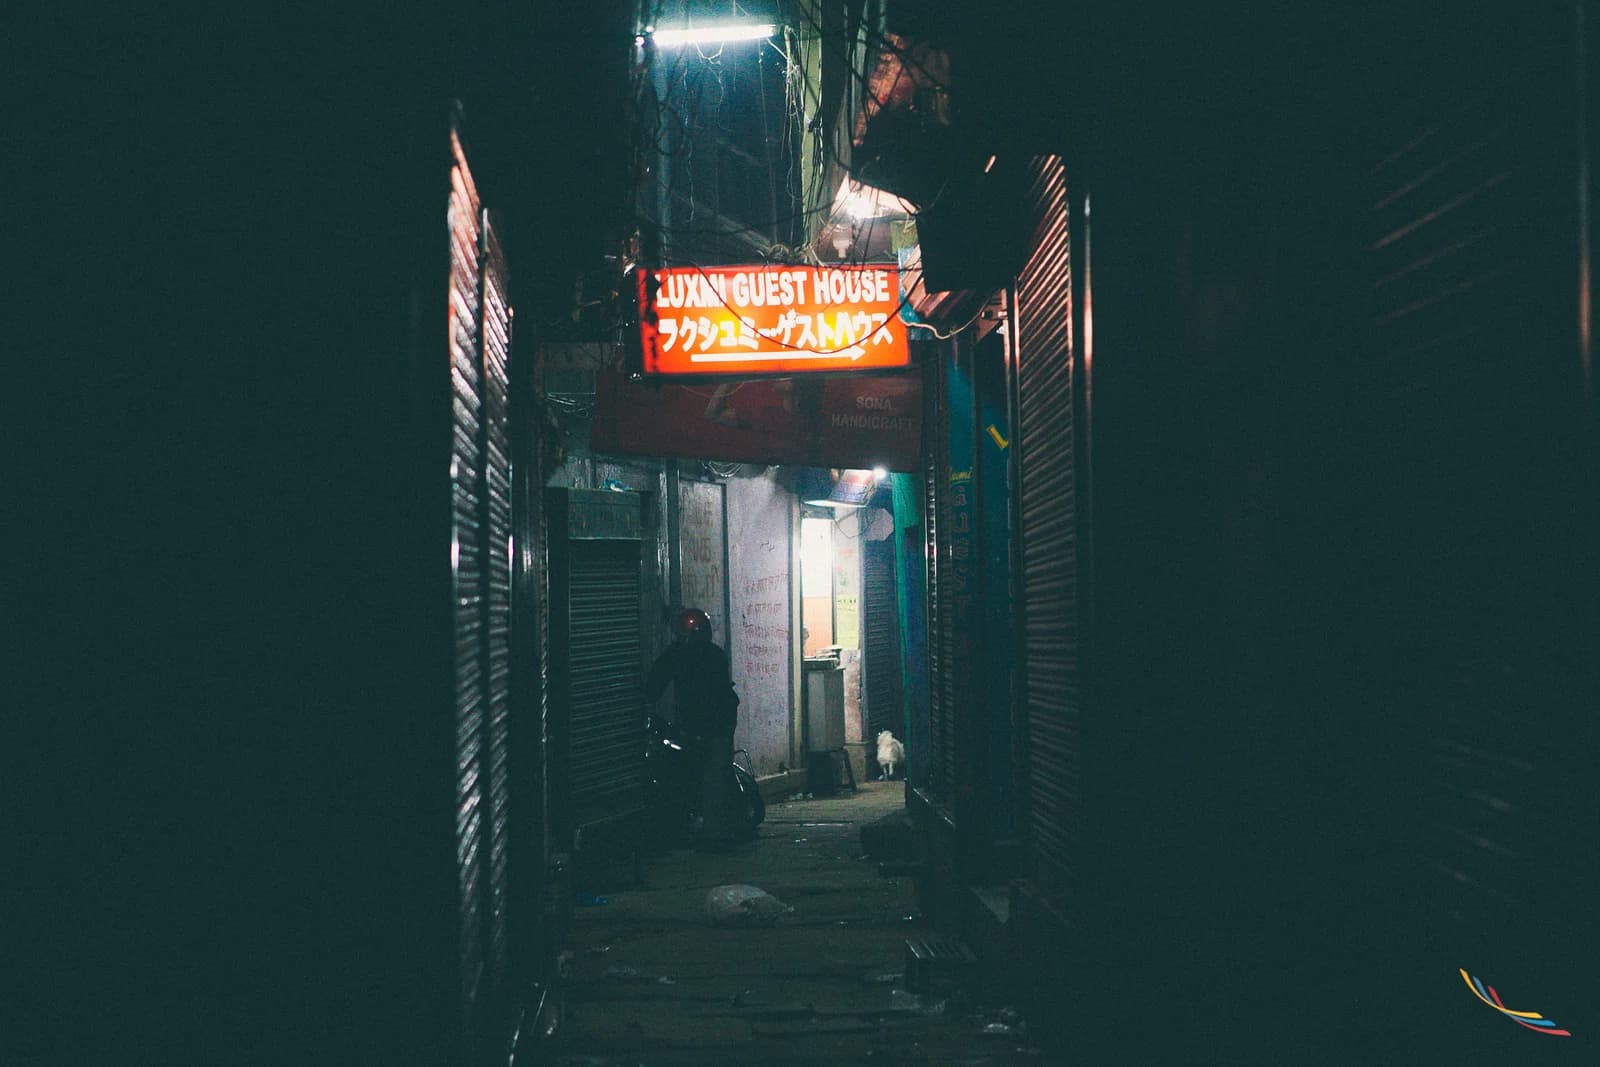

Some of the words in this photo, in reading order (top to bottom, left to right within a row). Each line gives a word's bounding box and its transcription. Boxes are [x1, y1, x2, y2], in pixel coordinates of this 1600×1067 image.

[655, 273, 727, 308] LUXMI
[733, 271, 807, 307] GUEST
[814, 269, 890, 305] HOUSE
[856, 396, 892, 410] SONA
[831, 413, 914, 431] HANDICRAFT
